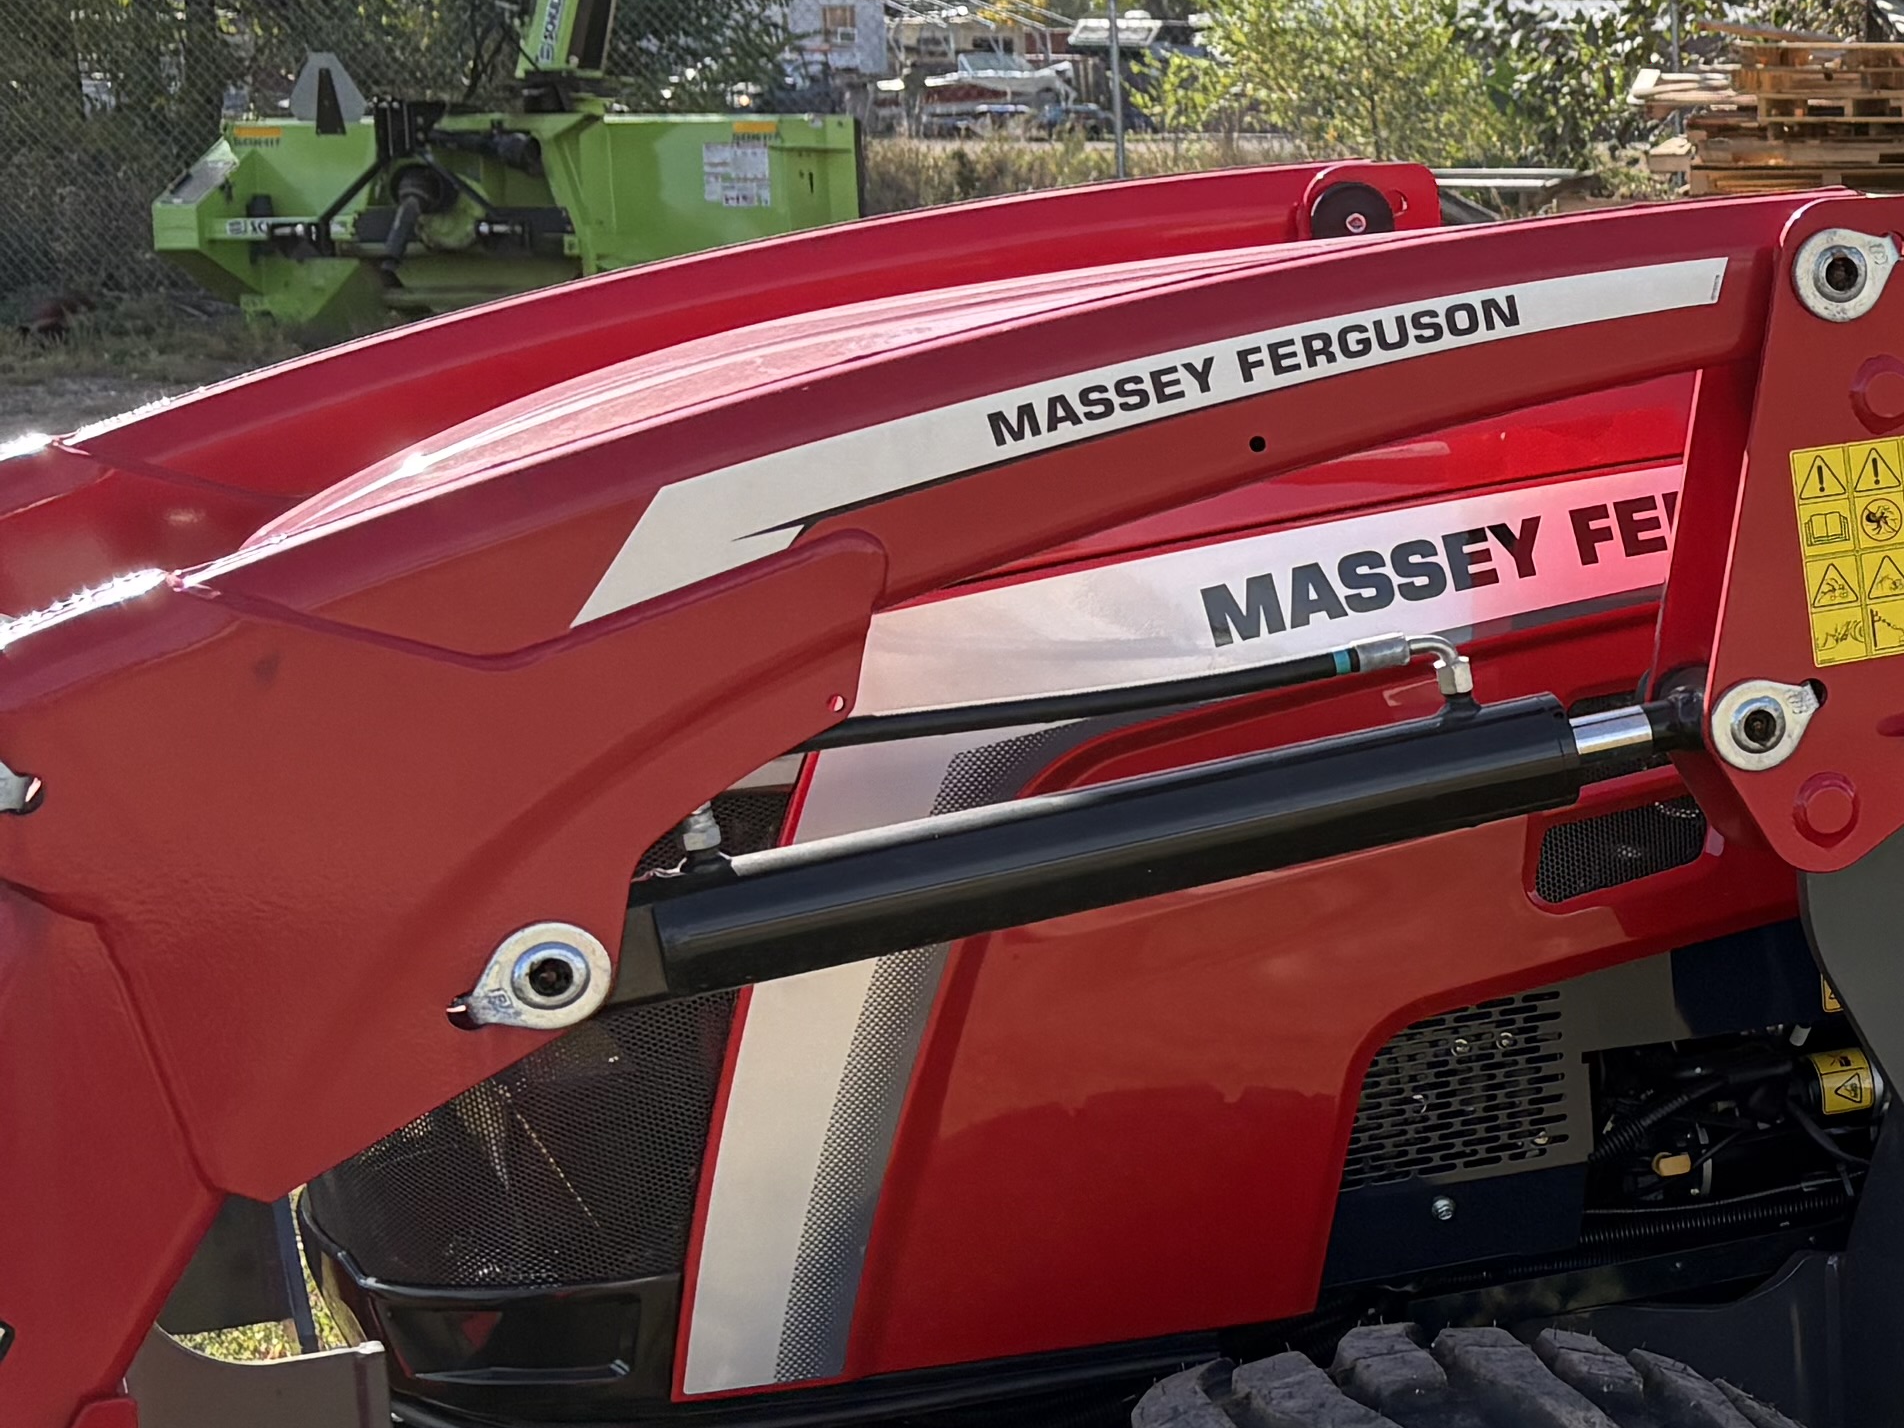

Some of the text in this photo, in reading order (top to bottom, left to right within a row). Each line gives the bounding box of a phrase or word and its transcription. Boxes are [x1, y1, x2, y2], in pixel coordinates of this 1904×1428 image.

[987, 294, 1520, 446] MASSEY FERGUSON
[1200, 515, 1541, 647] MASSEY
